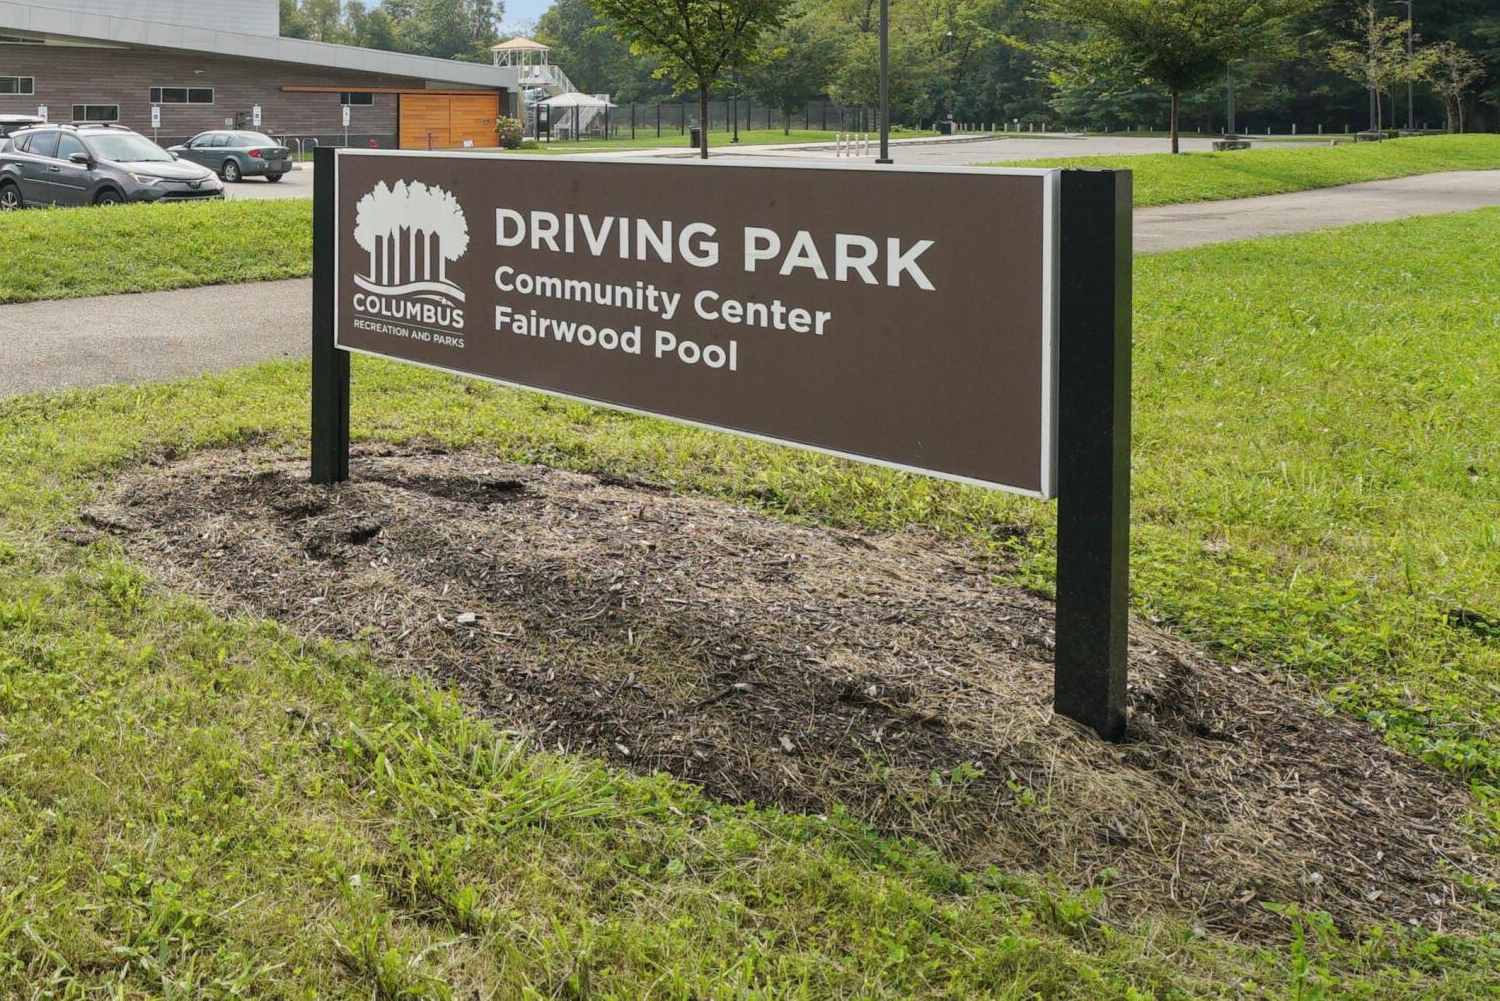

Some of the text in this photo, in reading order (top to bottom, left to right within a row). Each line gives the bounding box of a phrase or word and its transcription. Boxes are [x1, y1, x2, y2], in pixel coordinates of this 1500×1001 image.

[494, 207, 937, 291] DRIVING PARK
[352, 293, 464, 328] COLUMBUS
[353, 319, 465, 348] RECREATION AND PARKS
[494, 265, 832, 336] Community Center
[494, 305, 738, 372] Fairwood Pool
